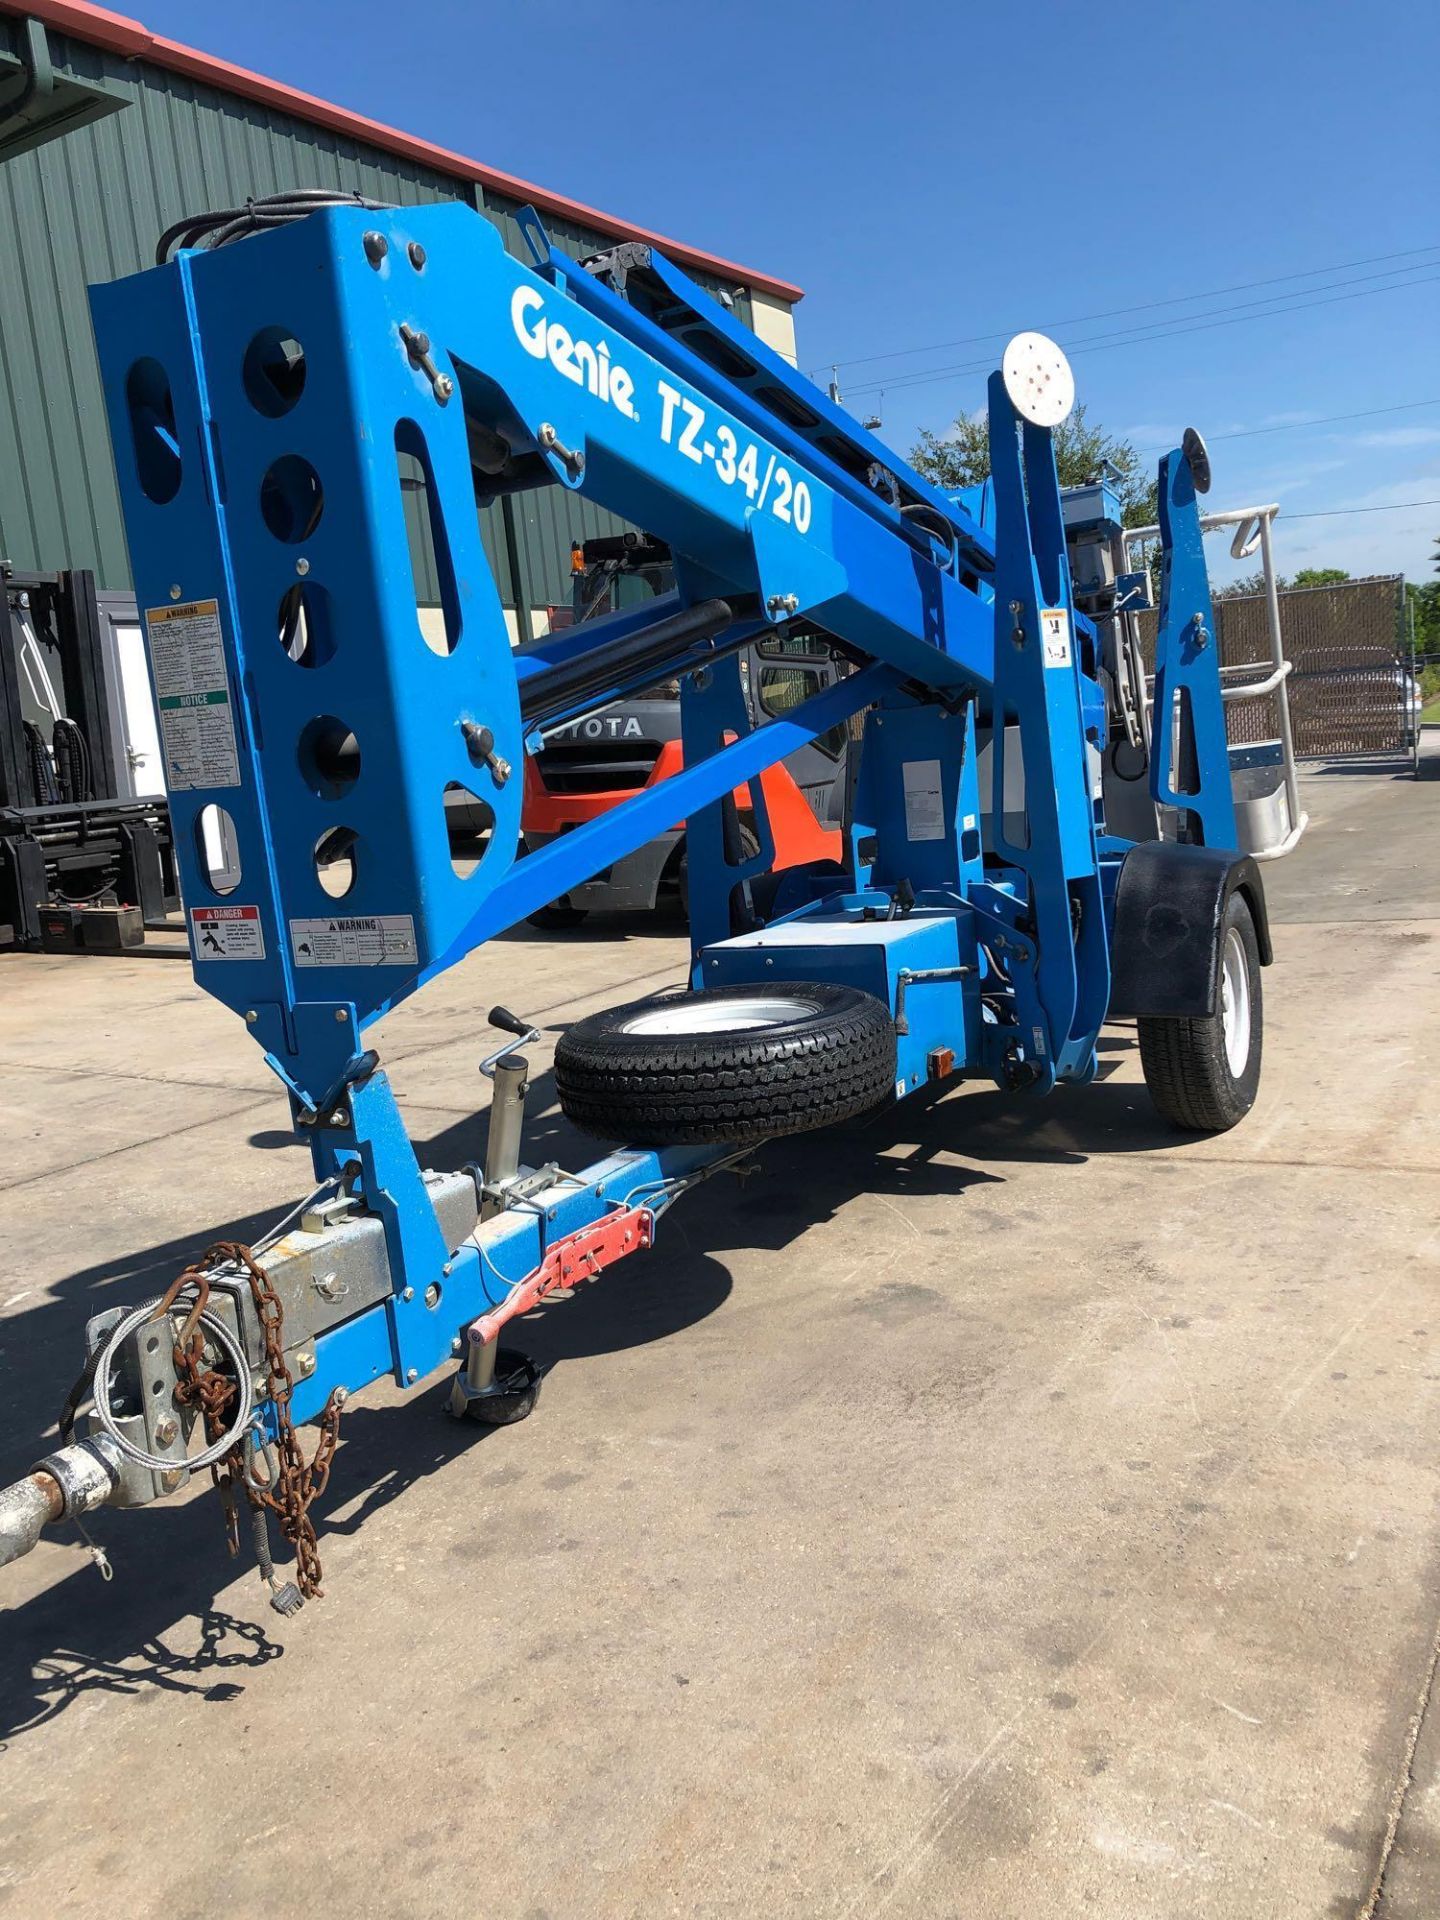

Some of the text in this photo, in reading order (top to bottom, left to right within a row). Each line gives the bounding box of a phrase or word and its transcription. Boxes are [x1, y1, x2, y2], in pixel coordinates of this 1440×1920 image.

[511, 285, 812, 534] Genie TZ-34/20
[171, 606, 198, 617] WARNING
[180, 694, 208, 706] NOTICE
[553, 717, 644, 739] YOTA
[213, 909, 243, 919] DANGER
[337, 920, 377, 931] WARNING
